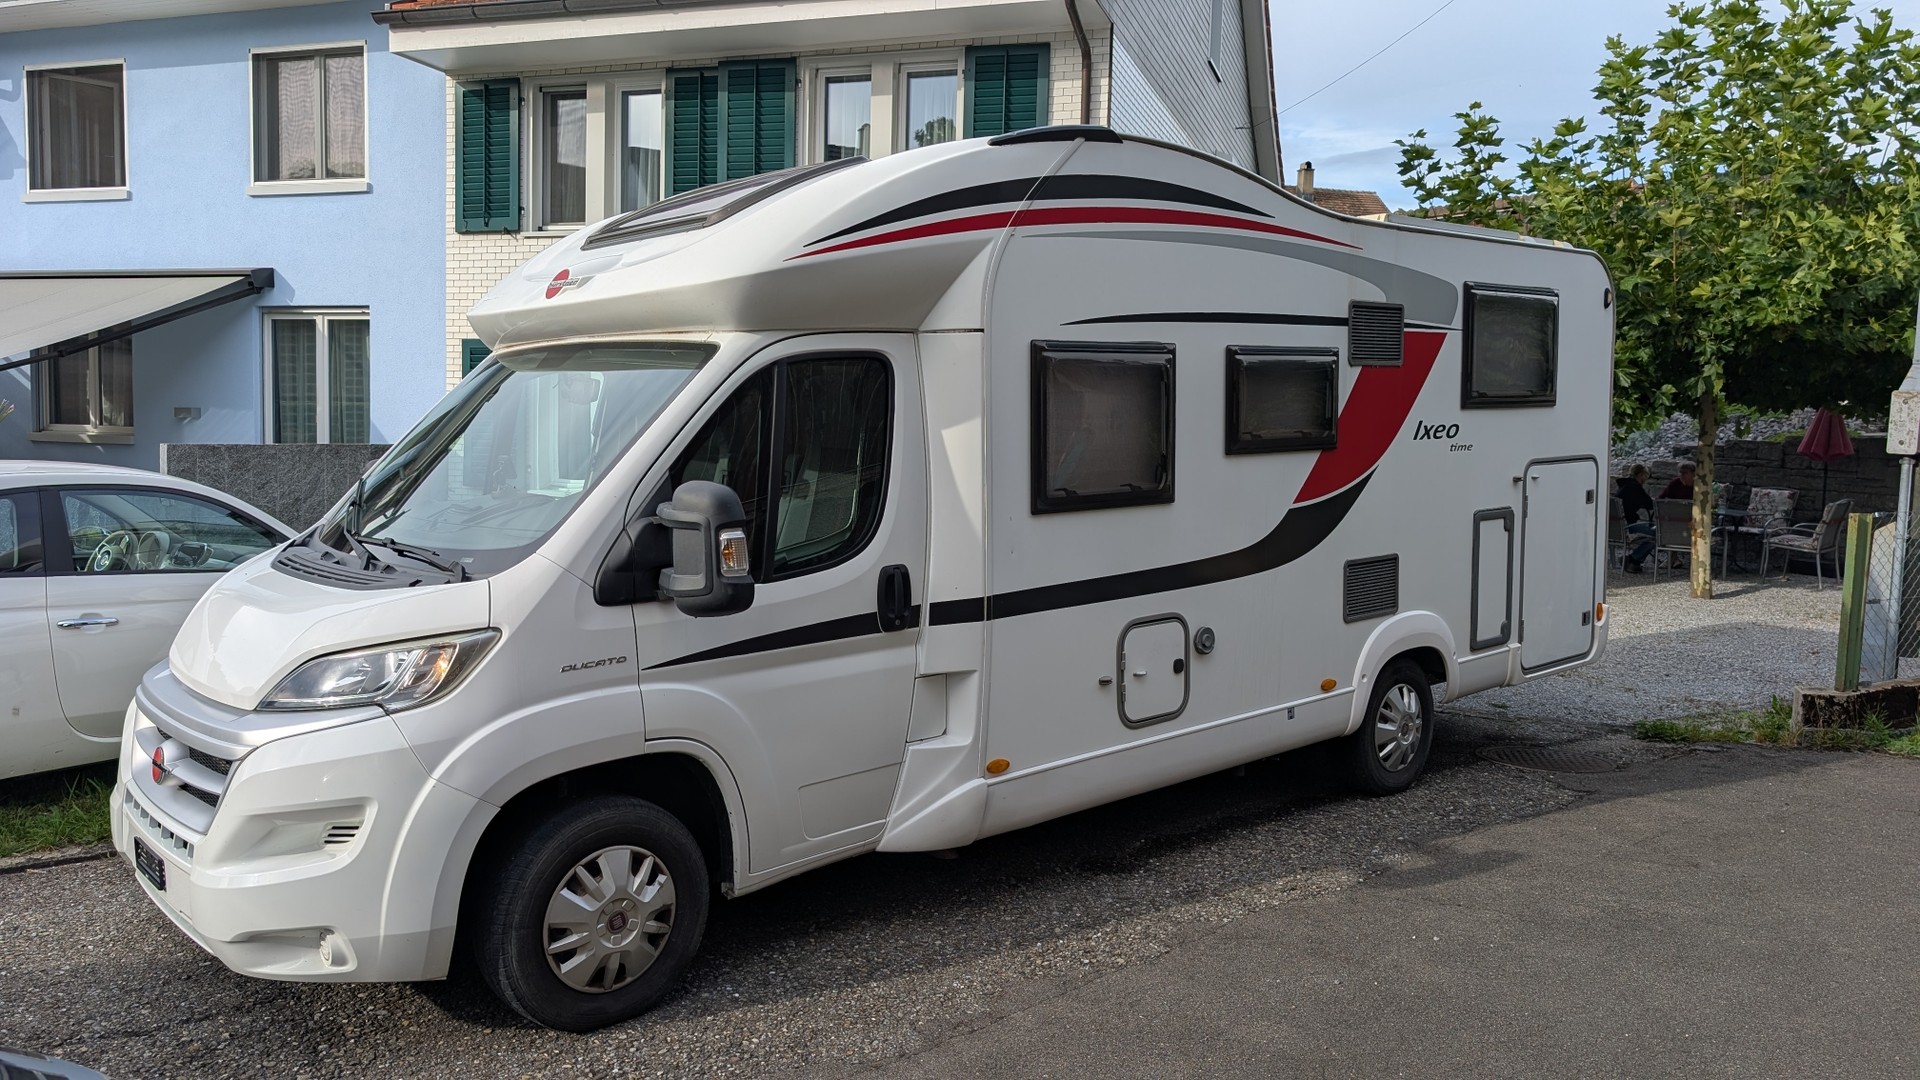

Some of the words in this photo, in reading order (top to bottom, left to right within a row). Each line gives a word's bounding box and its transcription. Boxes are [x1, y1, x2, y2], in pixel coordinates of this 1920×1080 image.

[1413, 420, 1460, 440] Ixeo
[1450, 443, 1473, 452] time
[560, 656, 627, 673] DUCATO
